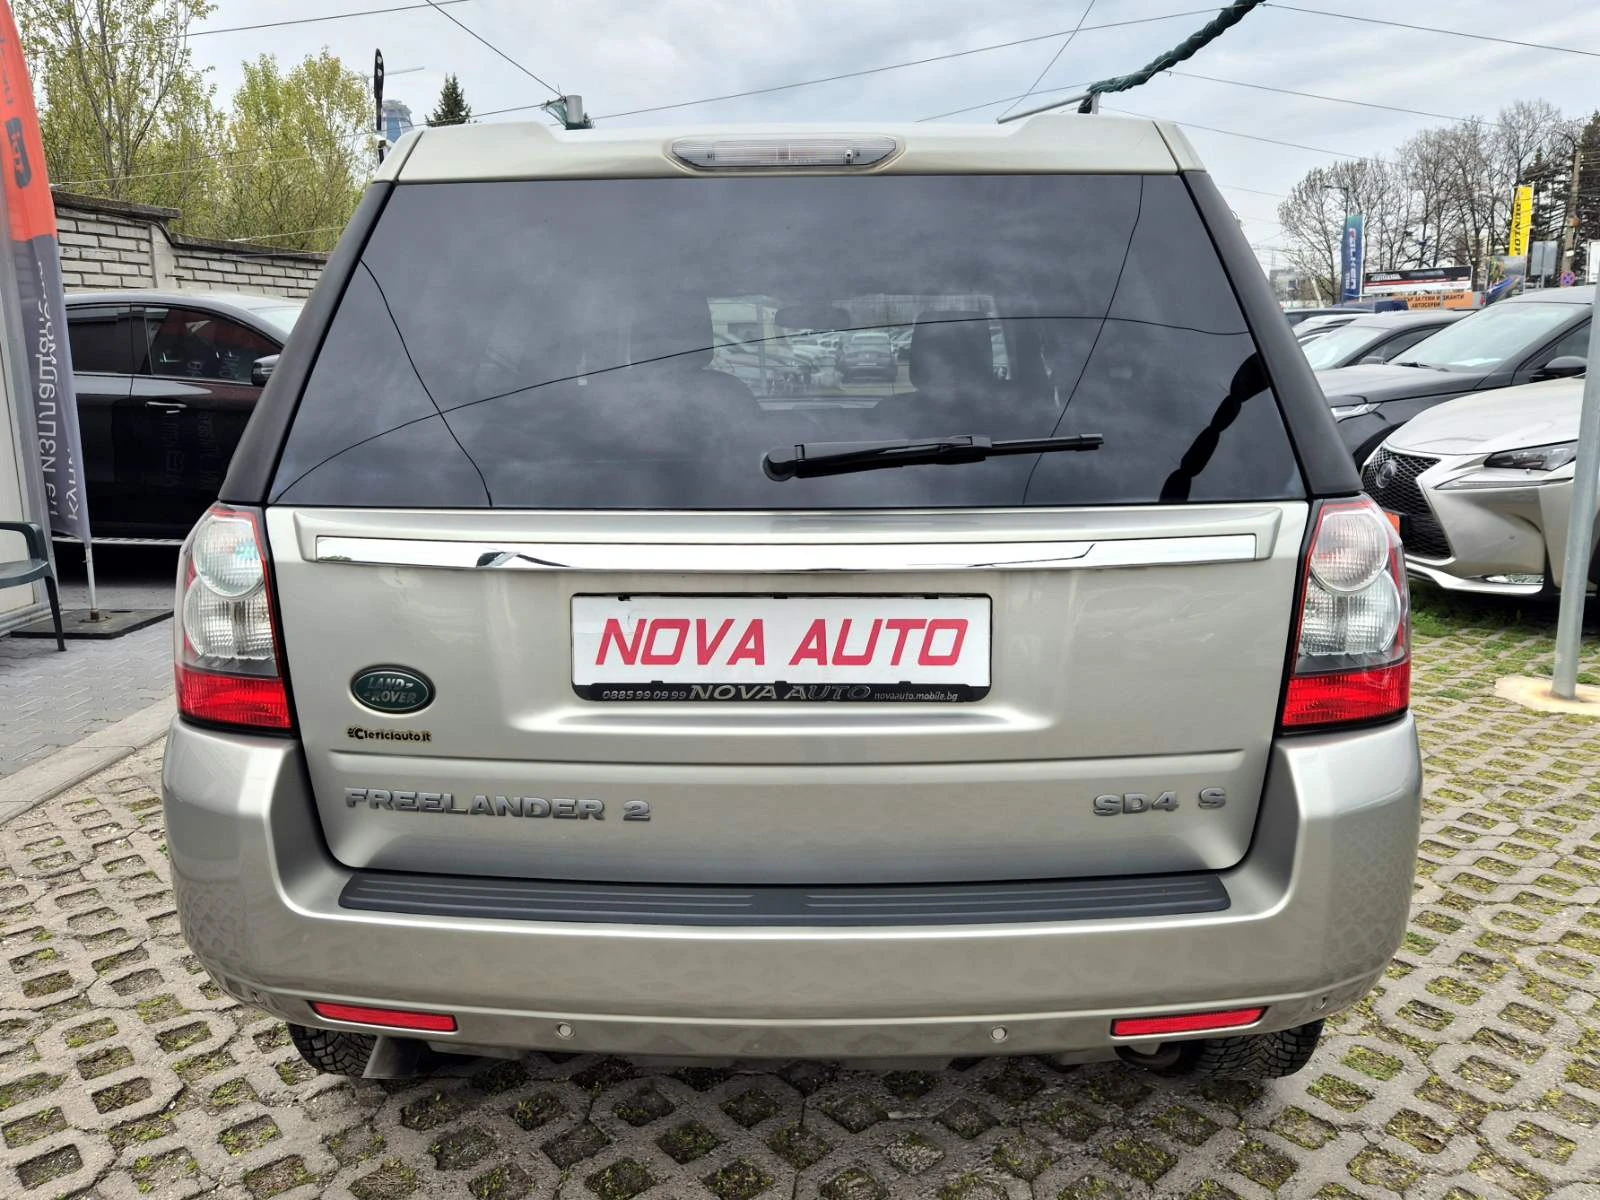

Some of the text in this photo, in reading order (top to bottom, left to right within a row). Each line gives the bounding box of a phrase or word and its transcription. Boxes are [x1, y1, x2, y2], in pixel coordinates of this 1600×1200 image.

[594, 617, 969, 666] NOVA AUTO
[370, 690, 417, 703] ROVER
[602, 684, 958, 702] 0885 99 09 99 NOVA AUTO novaauto.mobile.bg
[344, 787, 651, 822] FREELANDER 2
[1093, 787, 1227, 817] SD4 S
